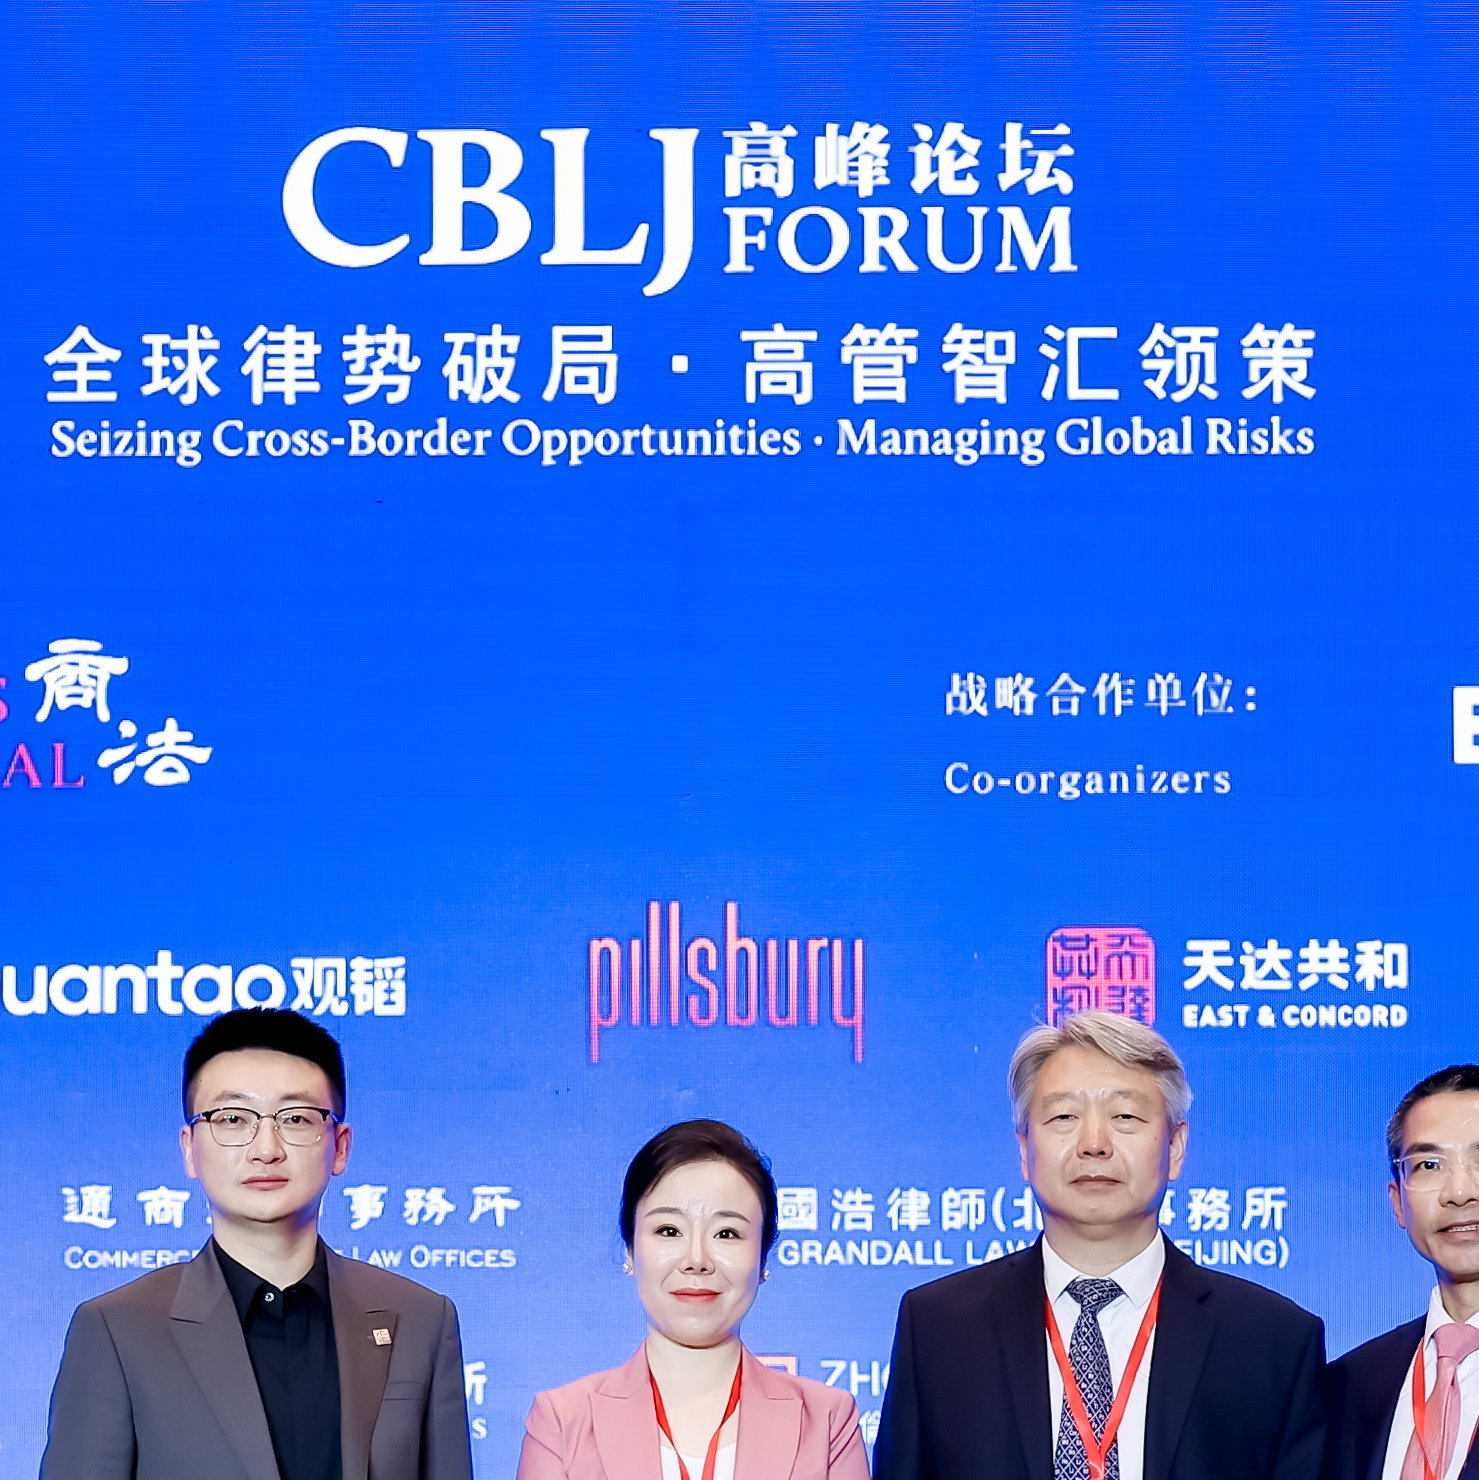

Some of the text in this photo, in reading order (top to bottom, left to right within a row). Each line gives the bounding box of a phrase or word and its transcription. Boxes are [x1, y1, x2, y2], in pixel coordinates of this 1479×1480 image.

[283, 122, 1074, 296] CBLJ 高峰论坛
[723, 206, 1077, 273] FORUM
[44, 323, 1316, 405] 全球律势破局·高管智汇领策
[52, 416, 1314, 467] Seizing Cross-Border Opportunities Managing Global Risks
[945, 762, 1230, 800] Co-organizers
[290, 957, 405, 1015] 观韬
[590, 901, 863, 1062] pillsbury
[1184, 939, 1408, 991] 天达共和
[1183, 1005, 1407, 1027] EAST & CONCORD
[411, 1244, 516, 1268] OFFICES
[778, 1240, 952, 1265] GRANDALL
